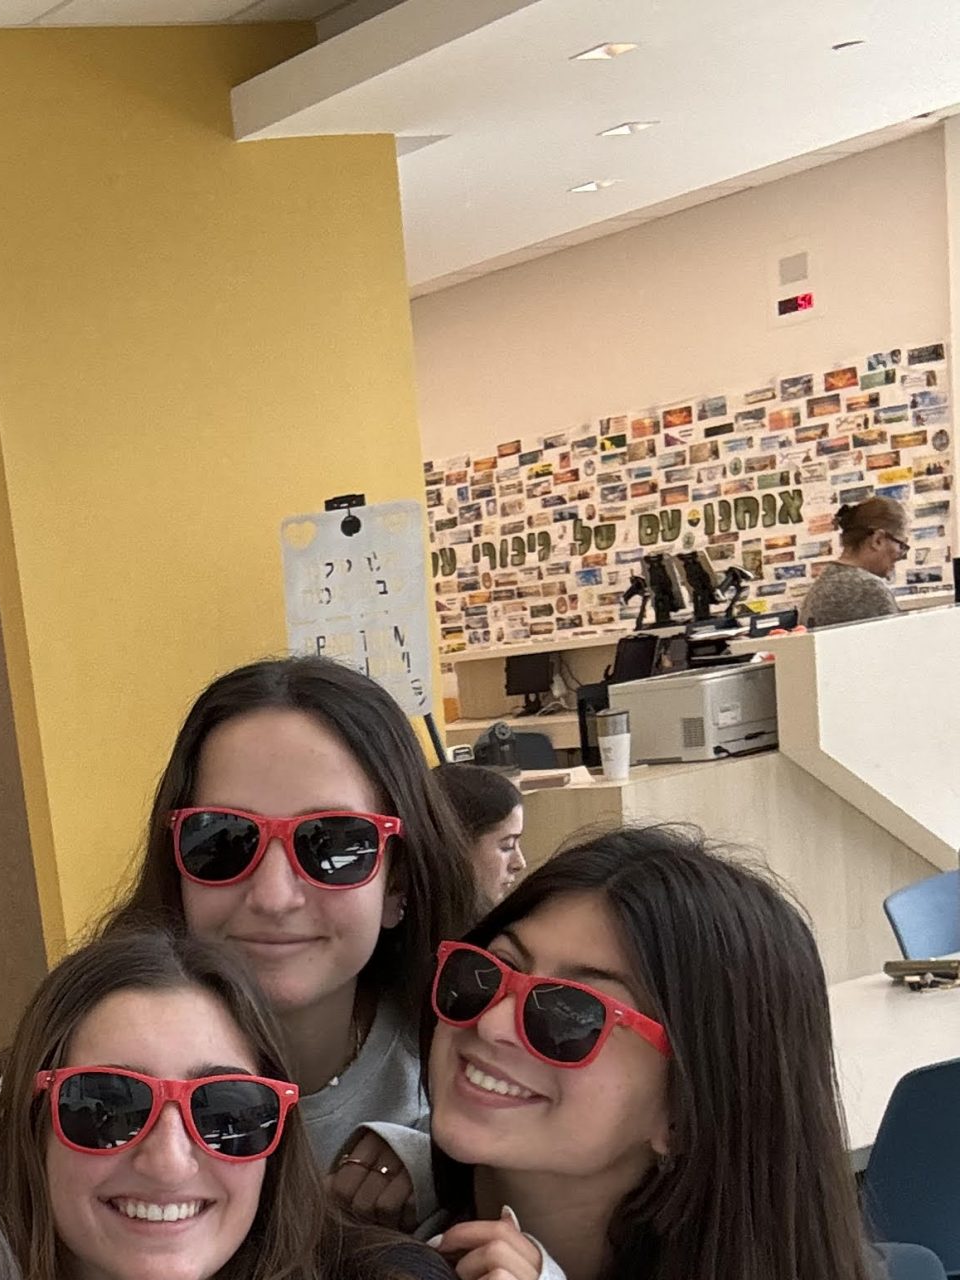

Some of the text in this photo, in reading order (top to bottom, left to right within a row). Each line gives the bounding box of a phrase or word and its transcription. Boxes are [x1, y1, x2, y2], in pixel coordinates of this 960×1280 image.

[431, 488, 804, 578] אנחנו עם של גיבורי ע
